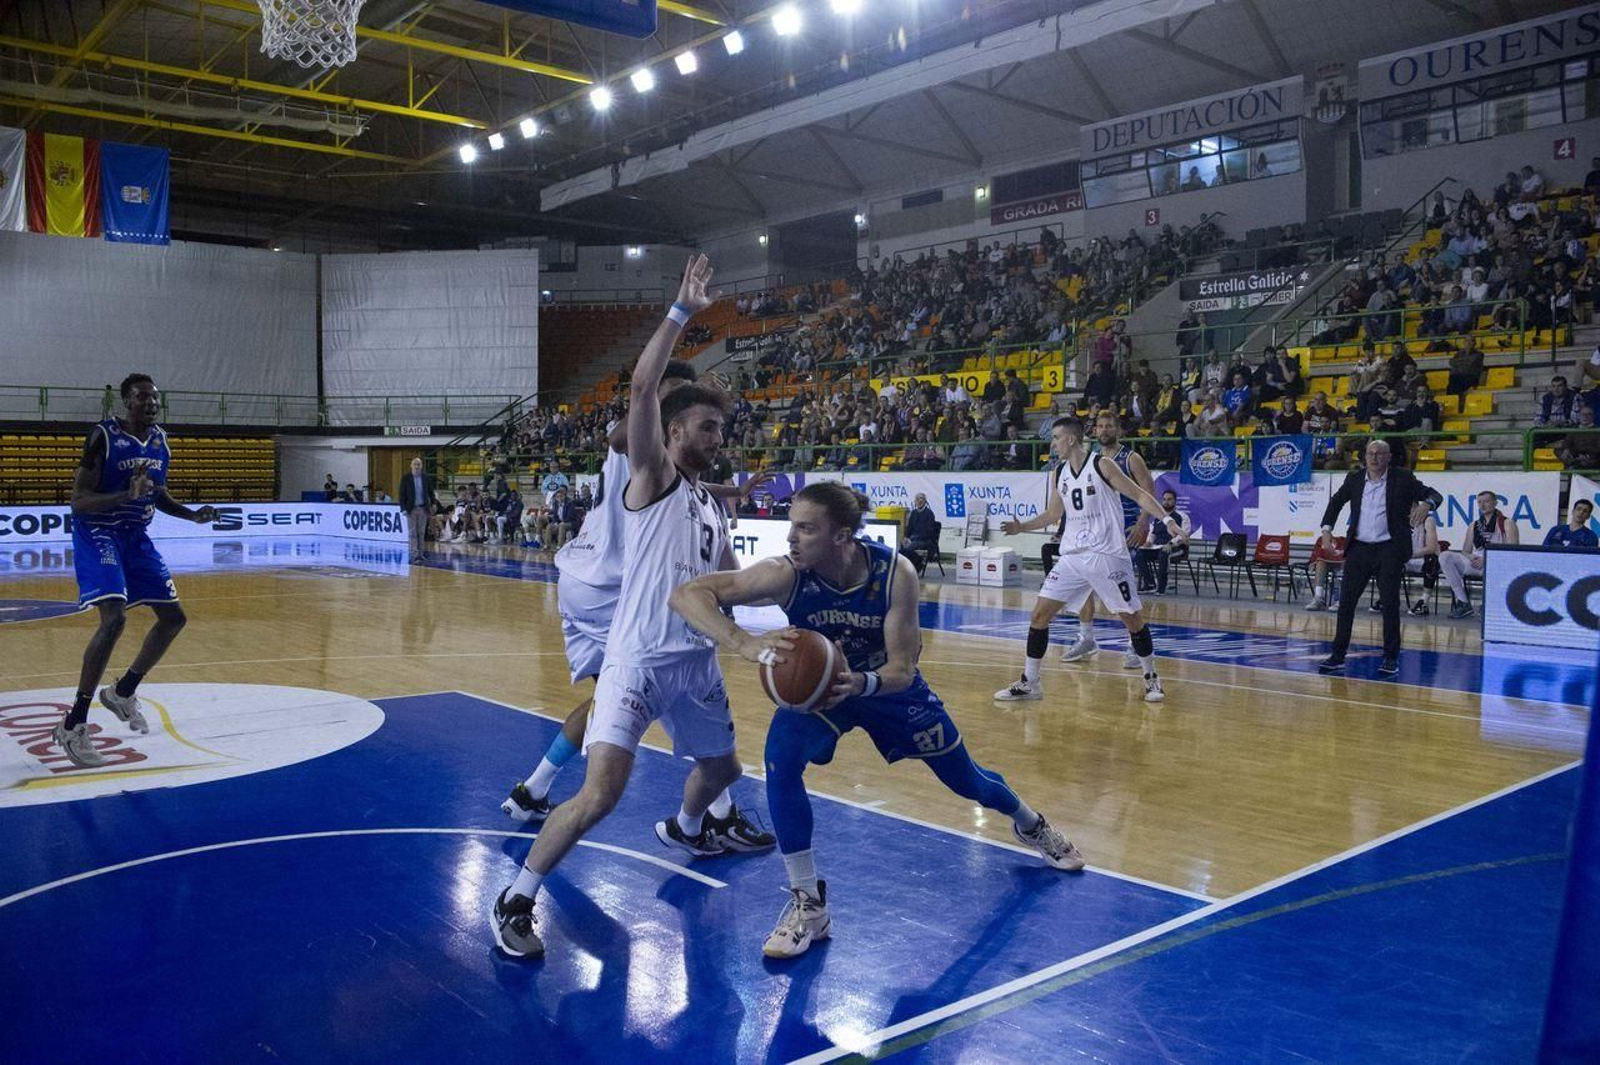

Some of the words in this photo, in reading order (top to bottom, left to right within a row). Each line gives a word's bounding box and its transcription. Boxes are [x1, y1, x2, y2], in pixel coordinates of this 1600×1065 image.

[1093, 86, 1284, 151] DEPUTACIÓN
[1558, 140, 1571, 157] 4
[1003, 198, 1059, 221] GRADA
[1147, 210, 1157, 225] 3
[1199, 278, 1246, 295] Estrella
[1048, 370, 1058, 389] 3
[870, 485, 908, 498] XUNTA
[969, 486, 1012, 499] XUNTA
[1071, 488, 1084, 511] 8
[989, 503, 1039, 517] GALICIA
[247, 512, 323, 526] SEAT
[343, 509, 403, 533] COPERSA
[1118, 580, 1131, 602] 8
